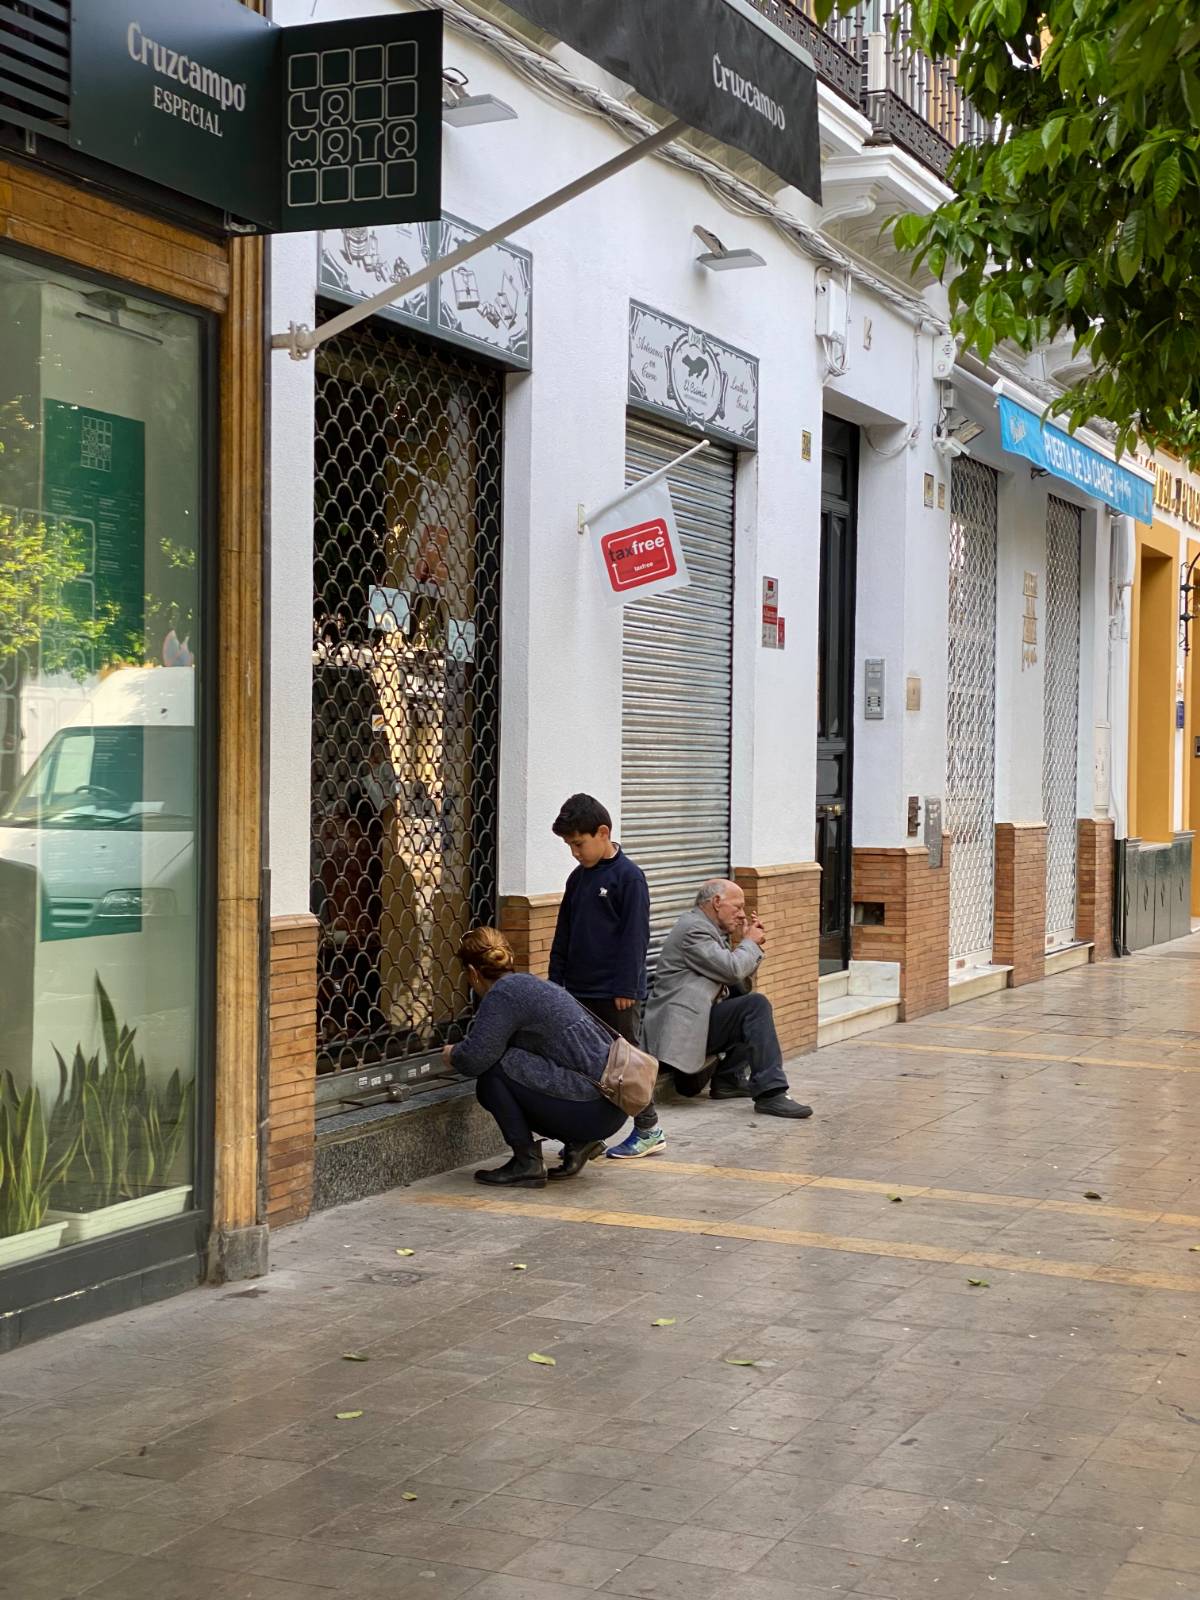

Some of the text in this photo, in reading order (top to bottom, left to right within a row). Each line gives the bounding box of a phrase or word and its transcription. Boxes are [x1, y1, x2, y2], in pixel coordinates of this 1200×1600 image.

[126, 21, 247, 112] Cruzcampo
[712, 53, 786, 131] Cruzcampo
[153, 85, 224, 138] ESPECIAL
[608, 536, 665, 562] taxfree
